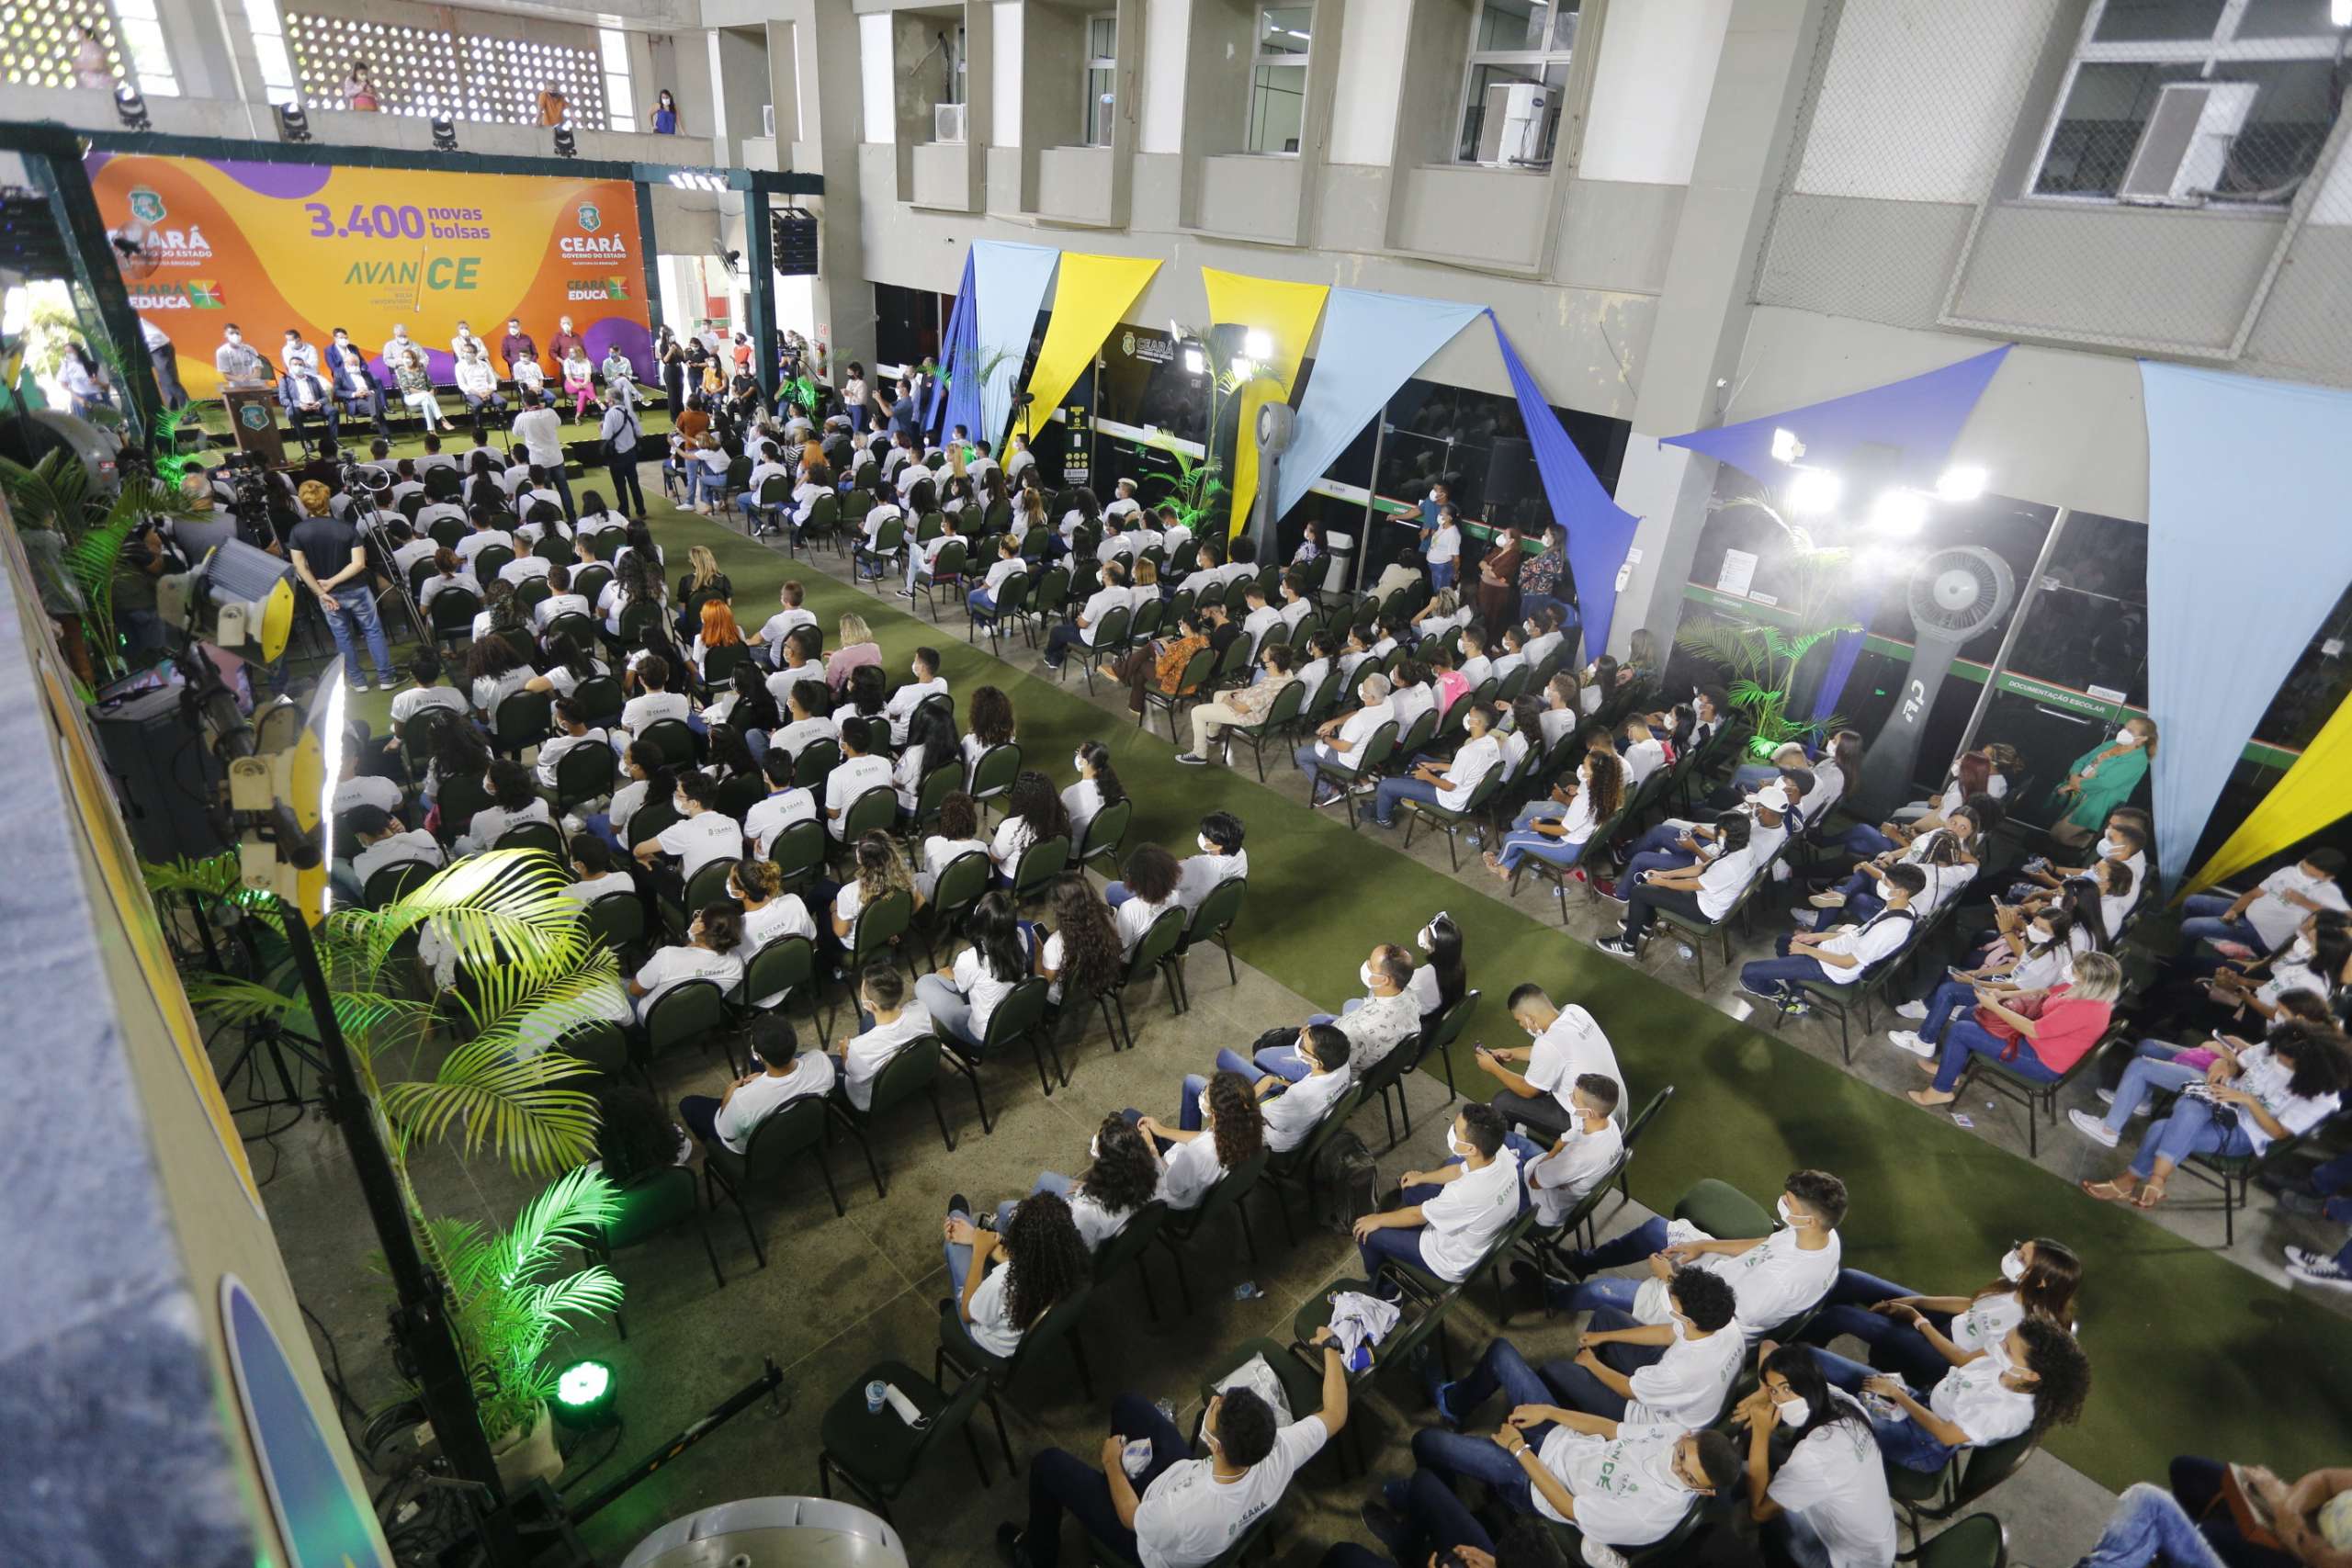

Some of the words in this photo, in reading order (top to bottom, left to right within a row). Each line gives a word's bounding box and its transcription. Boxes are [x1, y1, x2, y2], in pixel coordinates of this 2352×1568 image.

[305, 203, 425, 240] 3.400
[427, 207, 483, 221] novas
[430, 222, 492, 240] bolsas
[560, 232, 626, 253] CEARÁ
[129, 296, 191, 310] EDUCA
[568, 289, 608, 301] EDUCA
[2008, 680, 2069, 704] DOCUMENTAÇÃO
[2069, 698, 2106, 713] ESCOLAR
